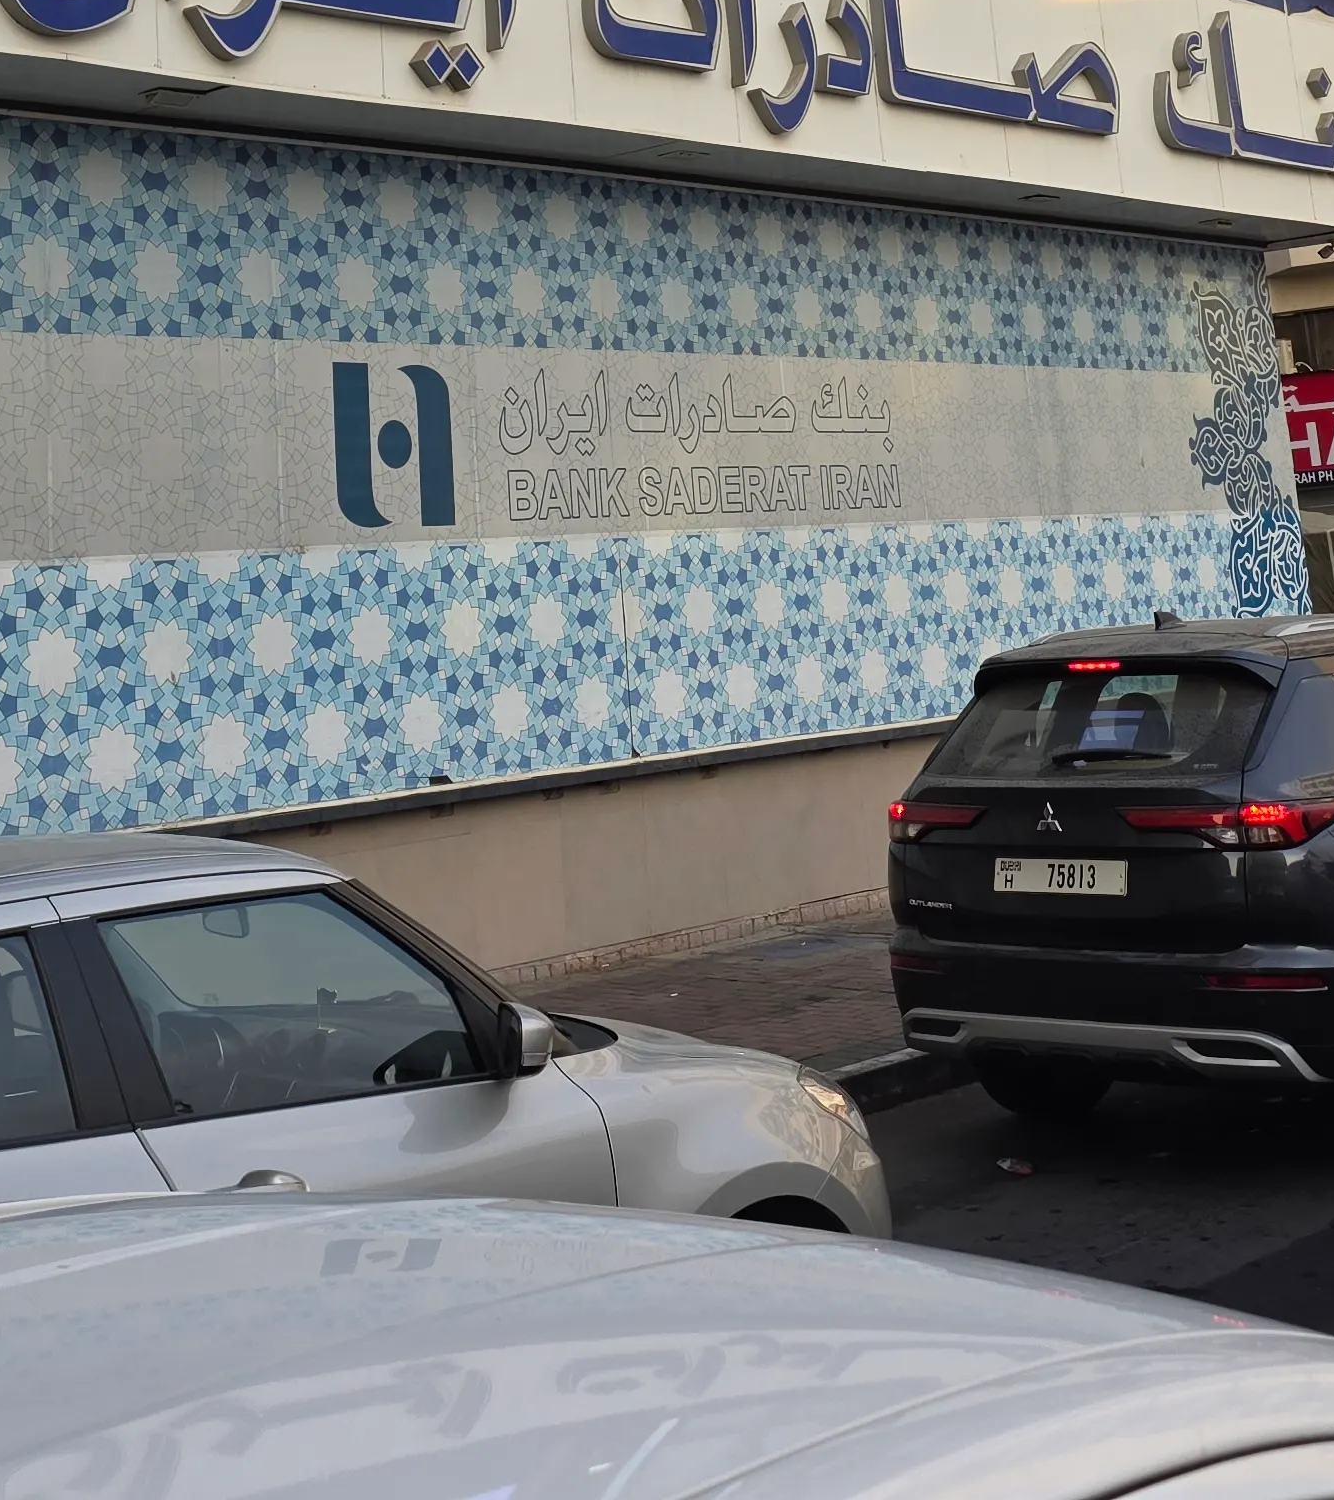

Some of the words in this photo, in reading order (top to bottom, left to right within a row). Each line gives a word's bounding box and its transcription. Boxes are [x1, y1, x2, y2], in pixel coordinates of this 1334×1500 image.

[624, 371, 798, 453] صادرات
[810, 376, 894, 453] بنك
[506, 466, 630, 522] BANK
[638, 464, 811, 518] SADERAT
[819, 463, 903, 510] IRAN
[908, 898, 954, 911] OUTLANDER
[1004, 873, 1015, 890] H
[1047, 863, 1097, 890] 75813
